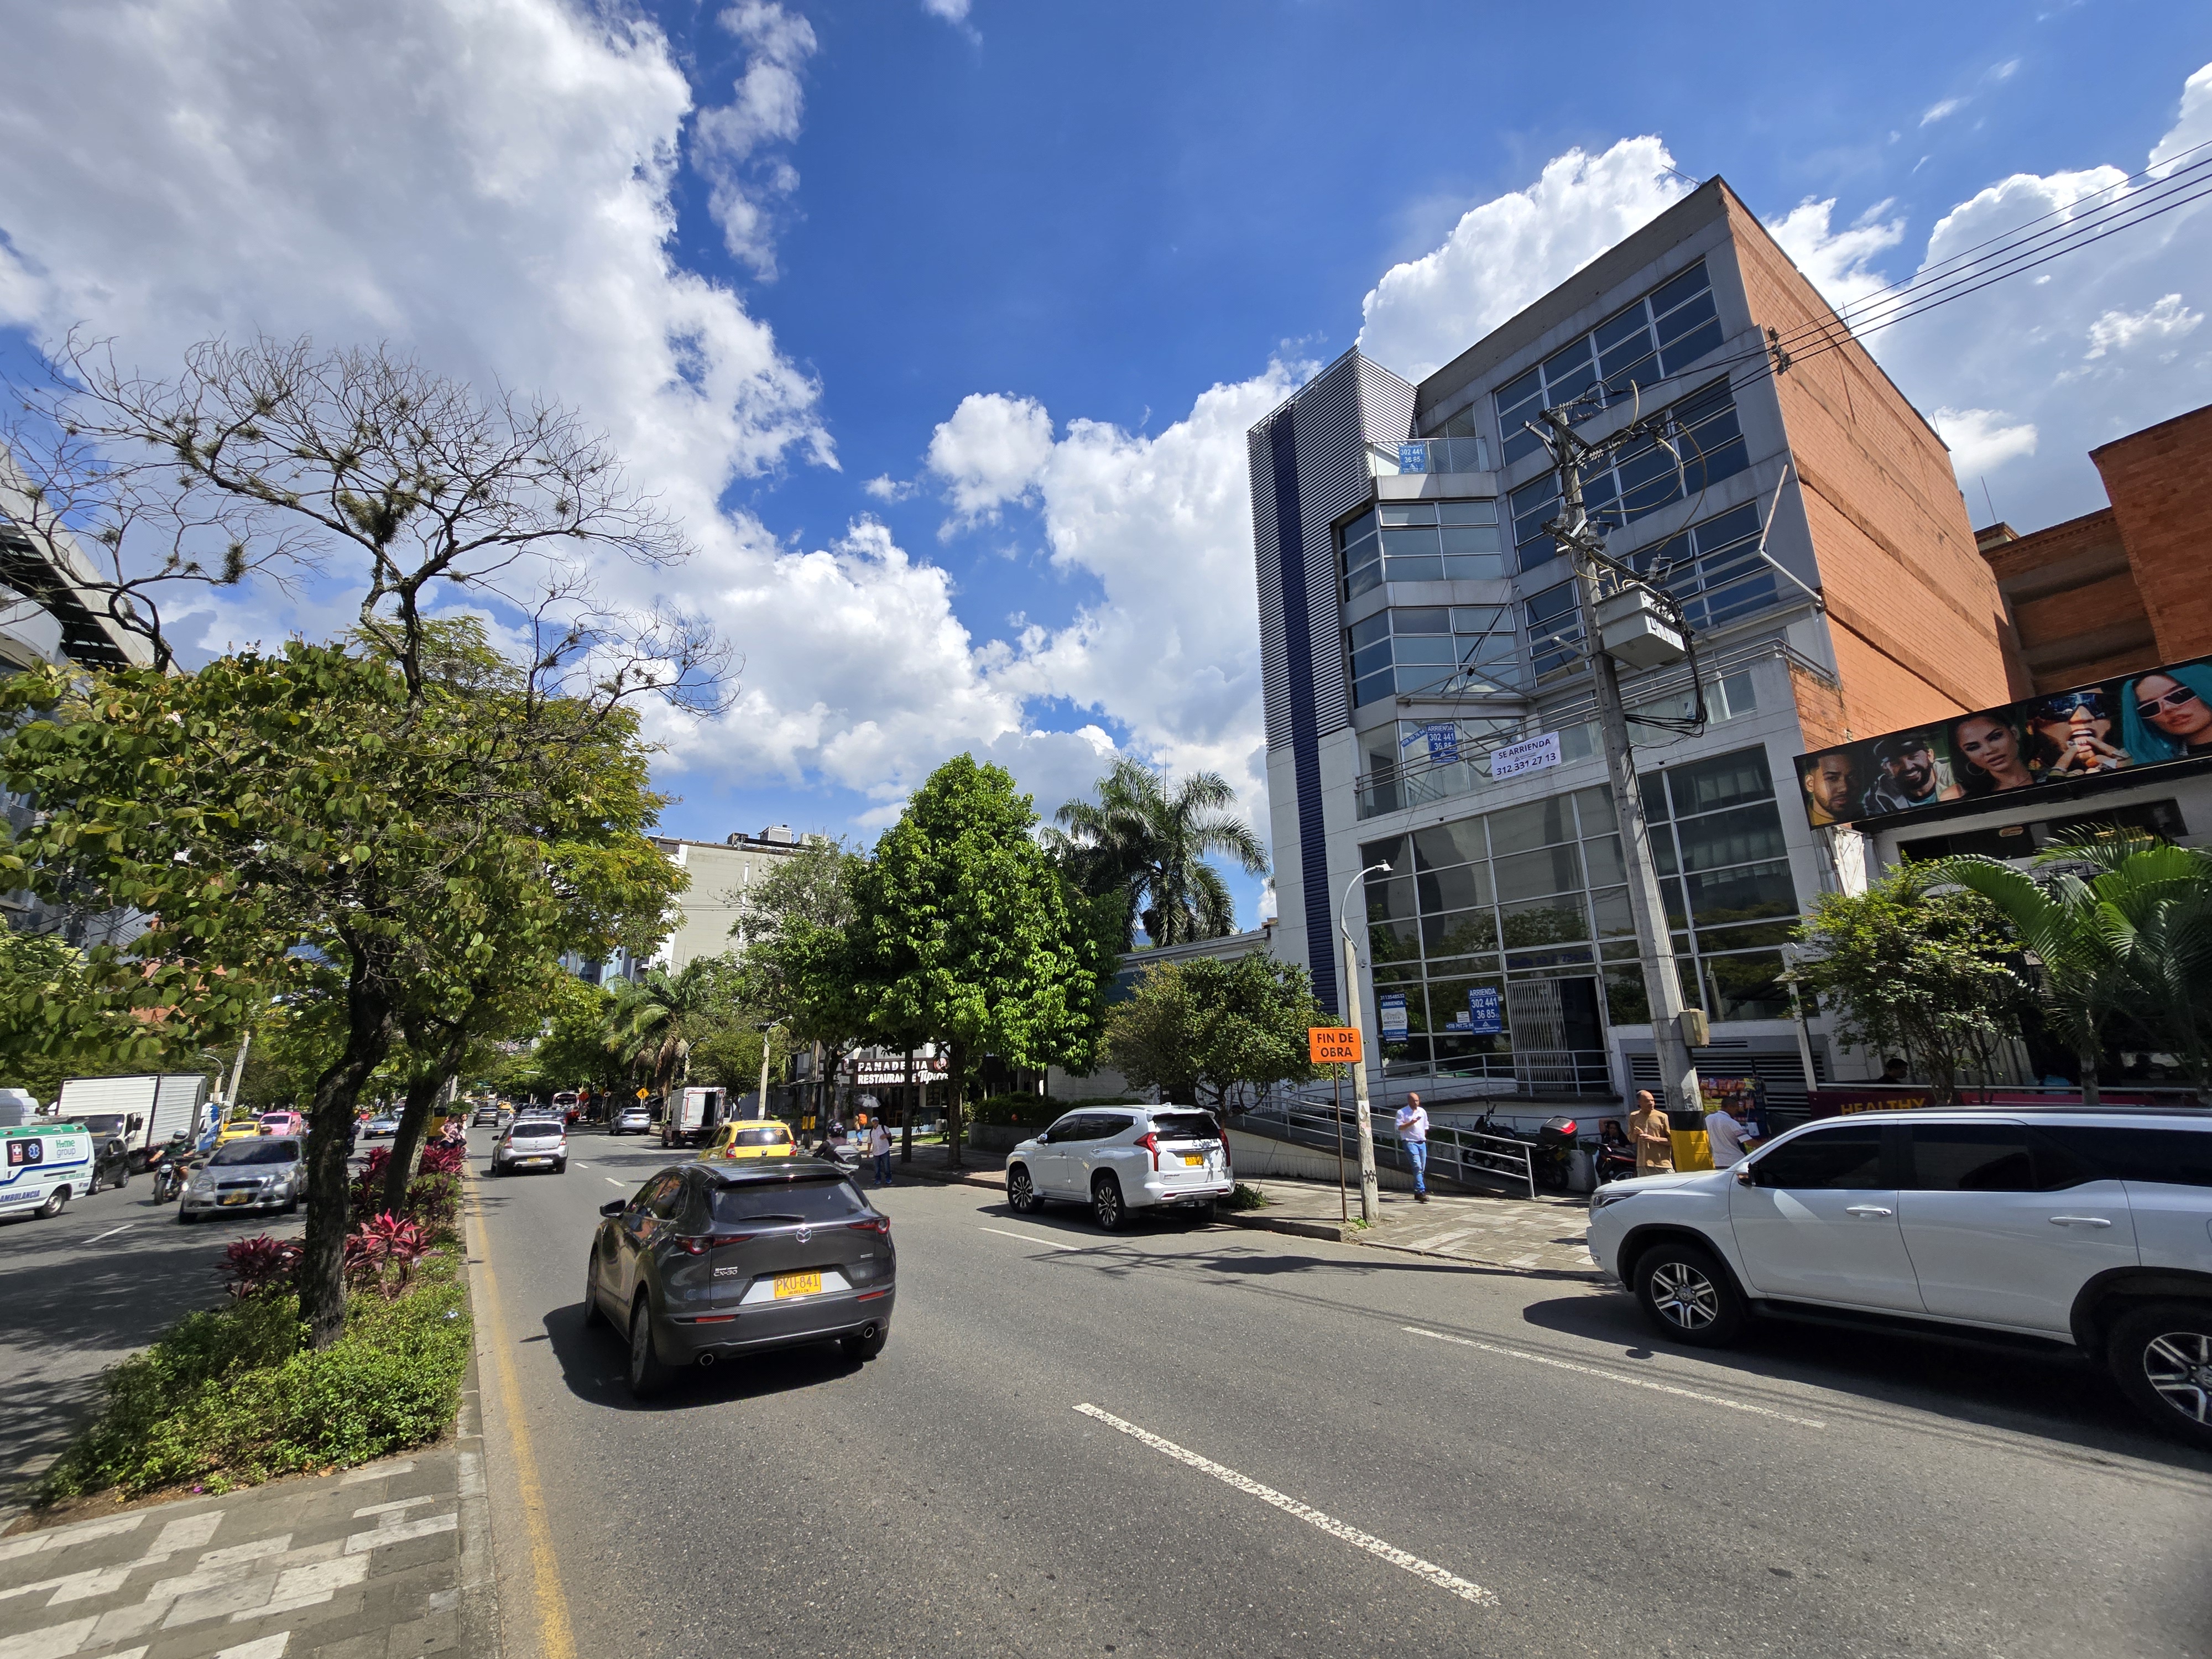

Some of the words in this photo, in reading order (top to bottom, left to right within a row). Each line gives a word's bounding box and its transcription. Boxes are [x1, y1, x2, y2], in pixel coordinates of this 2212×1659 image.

[1499, 751, 1507, 759] SE
[1509, 738, 1551, 756] ARRIENDA
[1496, 765, 1512, 775] 312
[1514, 760, 1529, 771] 331
[1532, 756, 1542, 765] 27
[1545, 753, 1556, 761] 13
[1469, 988, 1496, 997] ARRIENDA
[1471, 999, 1484, 1008] 302
[1485, 997, 1497, 1006] 441
[1477, 1010, 1485, 1019] 36
[1486, 1009, 1495, 1018] 85
[1317, 1033, 1335, 1043] FIN
[1339, 1033, 1354, 1043] DE
[1321, 1047, 1353, 1057] OBRA
[858, 1073, 916, 1084] RESTAURANE
[56, 1140, 75, 1148] Home
[57, 1148, 76, 1158] group
[1, 1190, 40, 1202] AMBULANCIA
[776, 1275, 818, 1291] PKU-841
